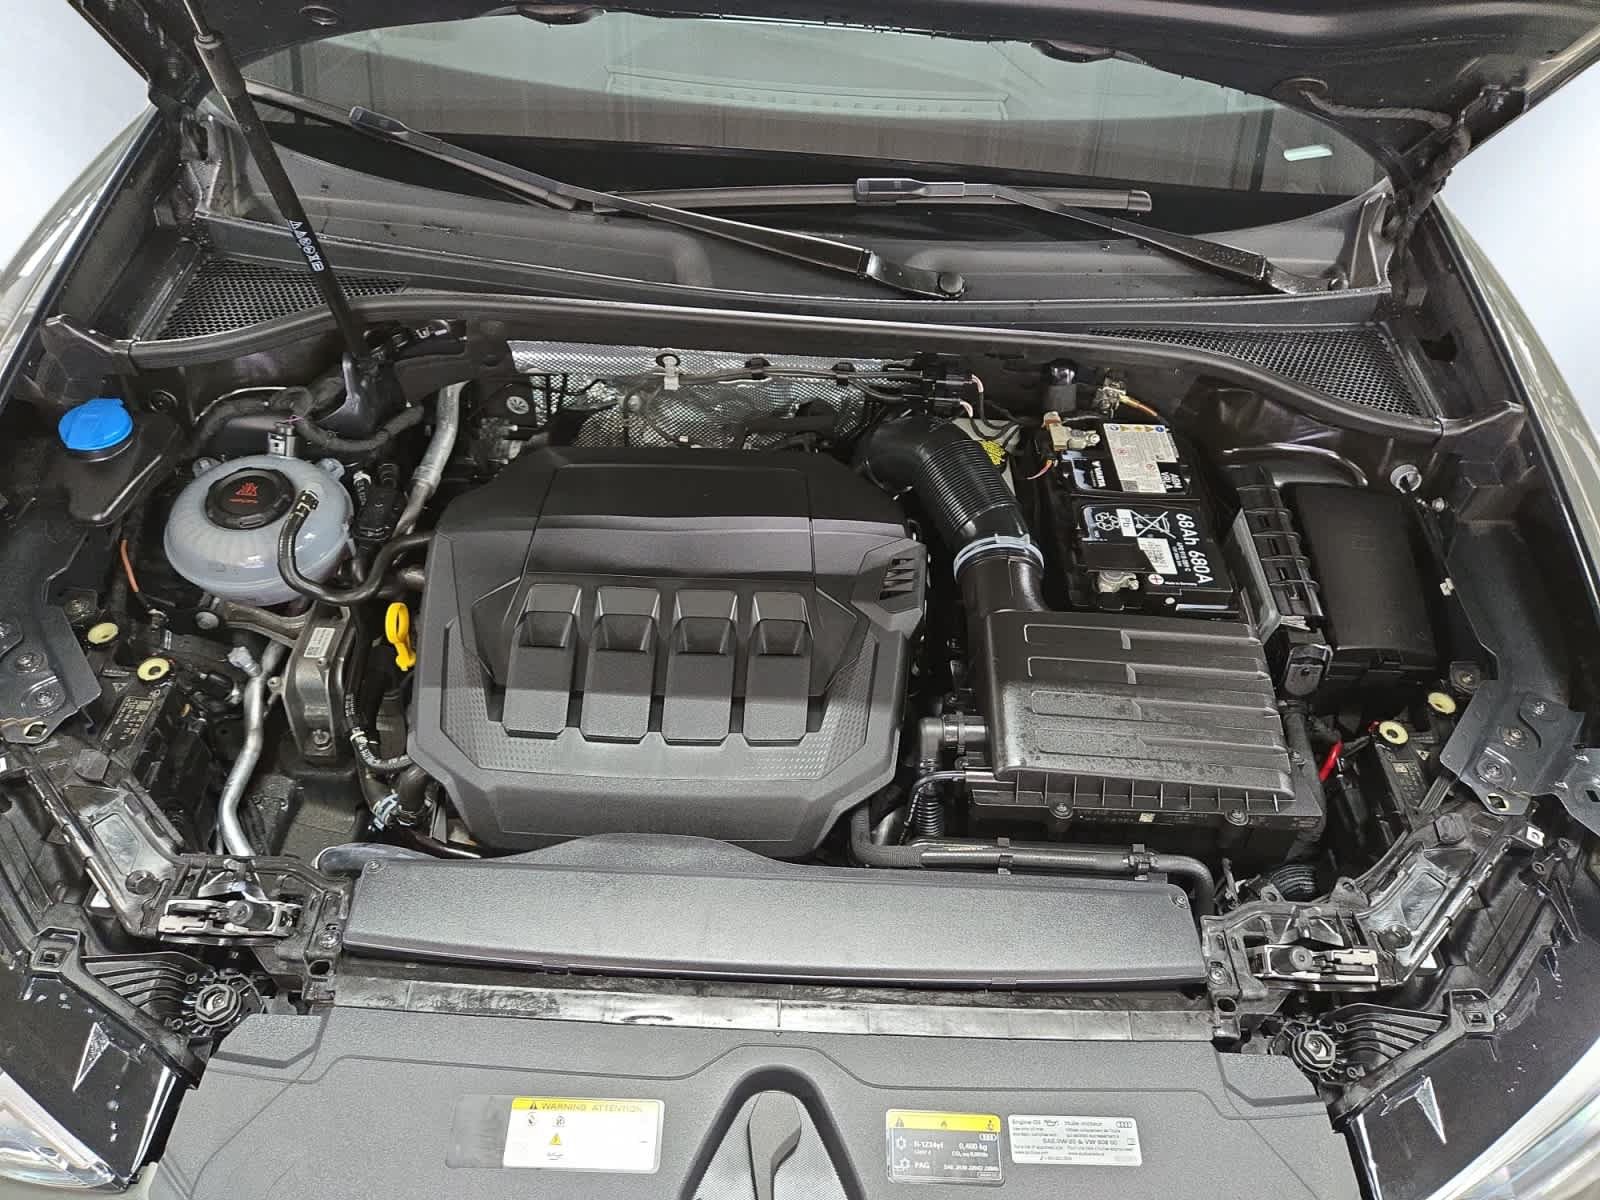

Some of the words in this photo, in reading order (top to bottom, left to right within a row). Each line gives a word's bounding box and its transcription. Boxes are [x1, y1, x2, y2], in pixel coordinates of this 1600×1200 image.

[1093, 467, 1106, 488] VARTA
[1160, 471, 1171, 489] VRLA
[1169, 473, 1183, 489] AGM
[1121, 516, 1131, 528] Pb
[1175, 513, 1201, 546] 68Ah
[1188, 550, 1214, 584] 680A
[541, 1103, 587, 1112] WARNING
[591, 1104, 643, 1113] ATTENTION
